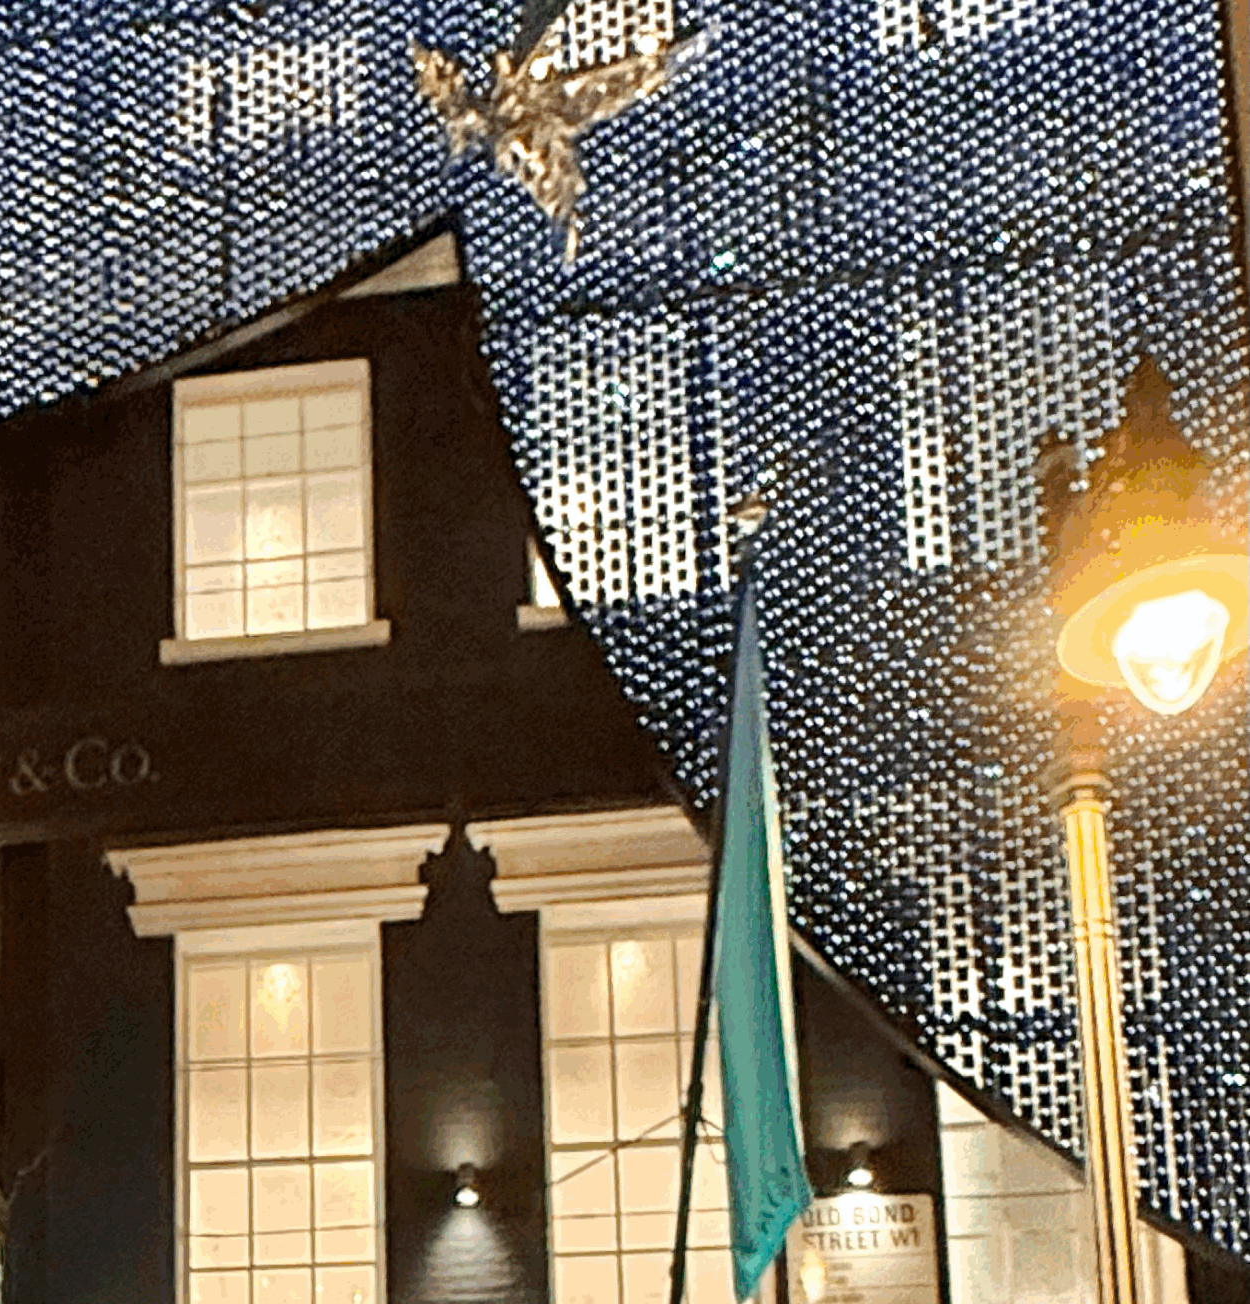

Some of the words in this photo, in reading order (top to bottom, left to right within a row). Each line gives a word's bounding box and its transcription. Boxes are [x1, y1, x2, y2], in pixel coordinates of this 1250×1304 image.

[802, 1205, 841, 1228] OLD
[802, 1231, 880, 1251] STREET
[890, 1227, 921, 1247] W1
